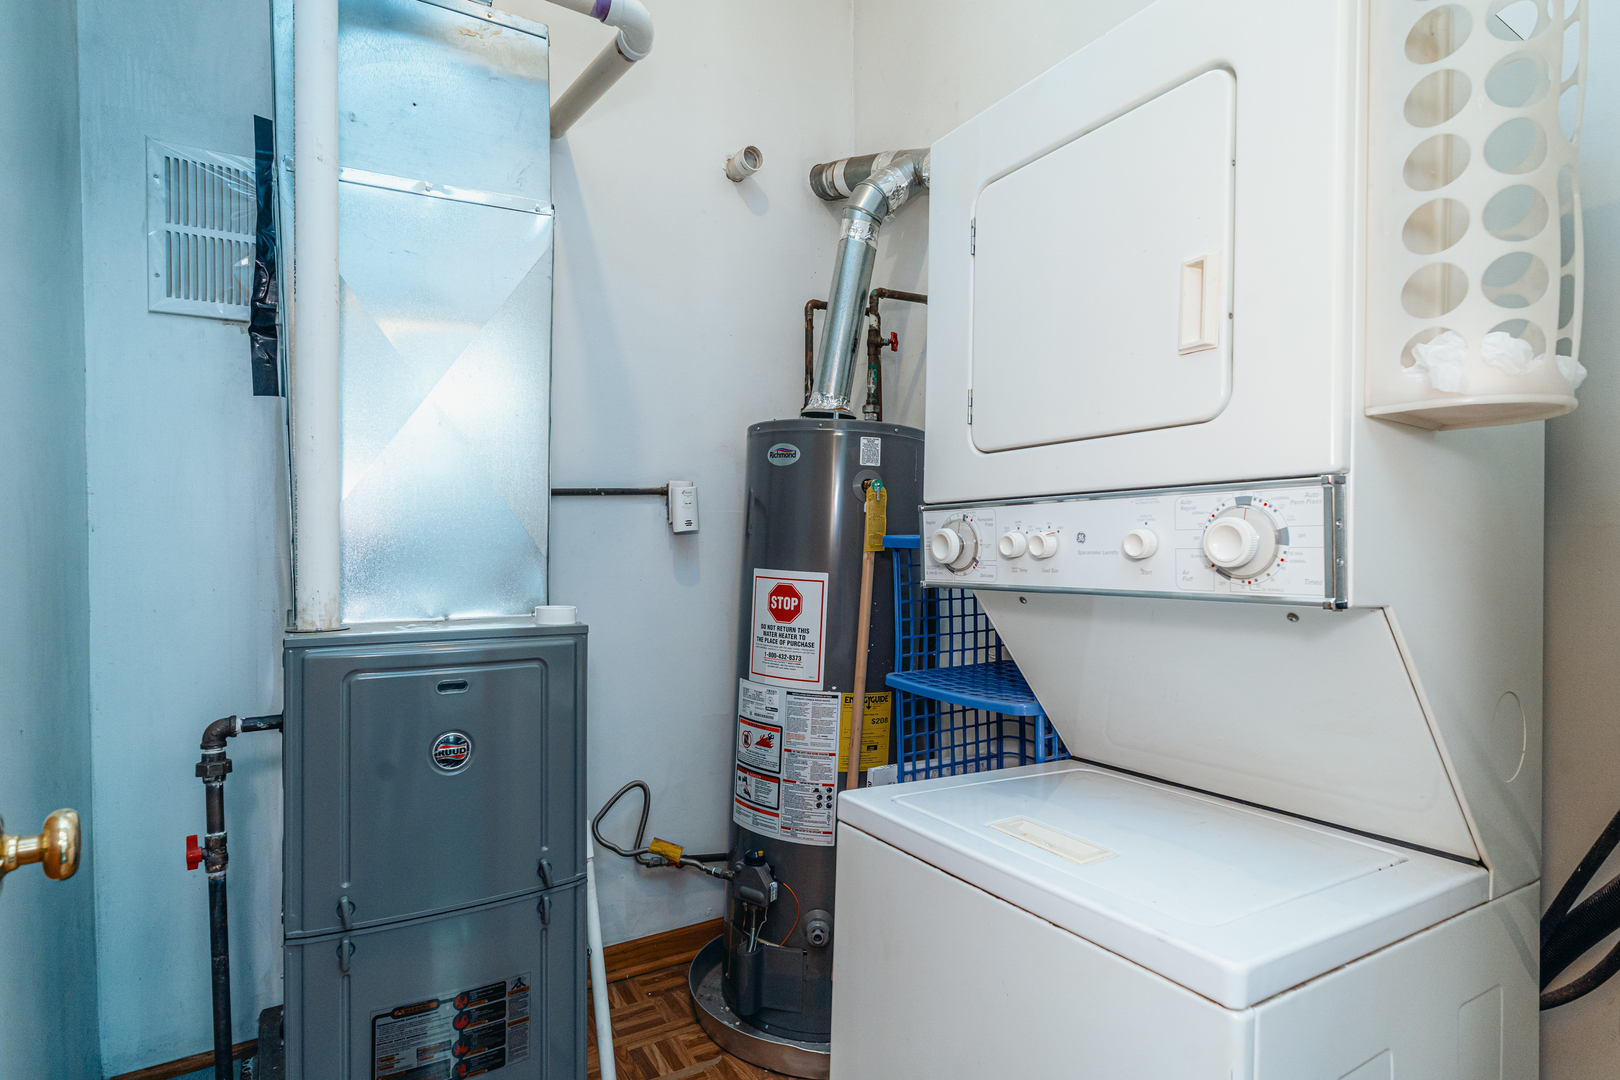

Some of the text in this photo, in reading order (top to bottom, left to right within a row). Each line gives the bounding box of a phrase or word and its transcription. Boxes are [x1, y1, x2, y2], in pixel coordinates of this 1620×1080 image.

[770, 451, 797, 459] Richmond
[771, 596, 798, 610] STOP
[787, 640, 815, 648] PURCHASE
[764, 652, 802, 662] 1-800-432-8373
[844, 695, 889, 704] ENGYGUIDE
[439, 747, 466, 756] RUUD
[403, 1004, 431, 1014] WARNING
